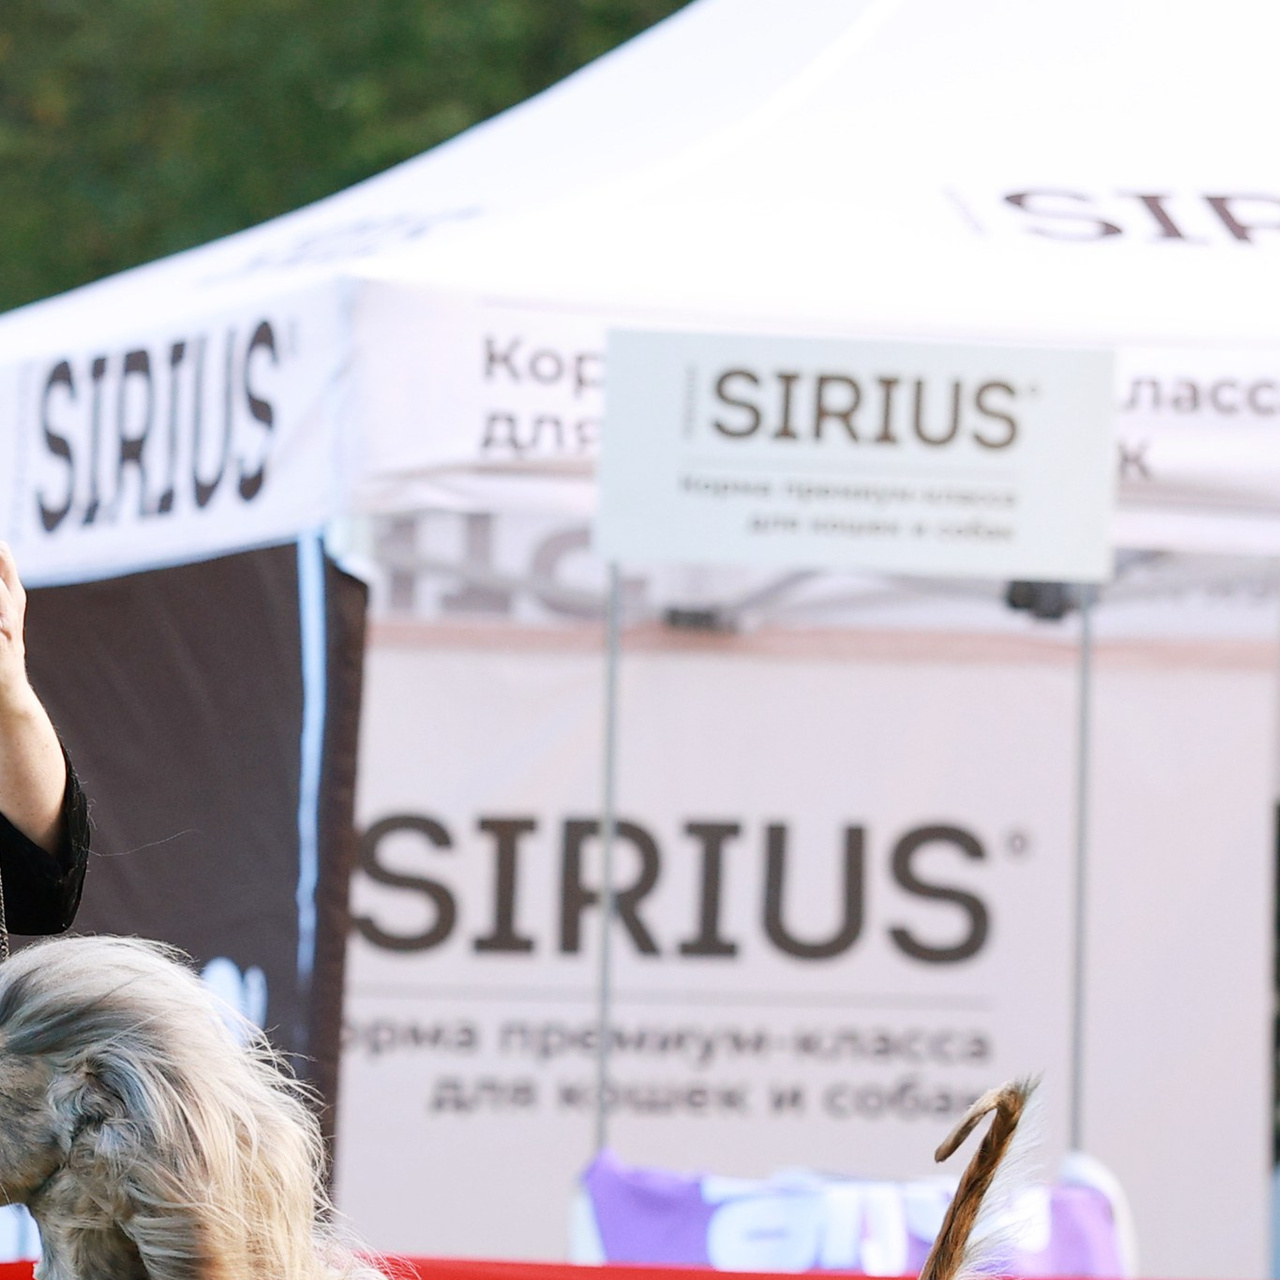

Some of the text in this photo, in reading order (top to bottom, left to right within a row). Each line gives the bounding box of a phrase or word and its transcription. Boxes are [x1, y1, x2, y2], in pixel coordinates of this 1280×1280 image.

[483, 336, 607, 398] Кор
[711, 367, 1022, 452] SIRIUS
[35, 319, 280, 534] SIRIUS
[351, 812, 993, 964] SIRIUS
[339, 1021, 479, 1061] орма
